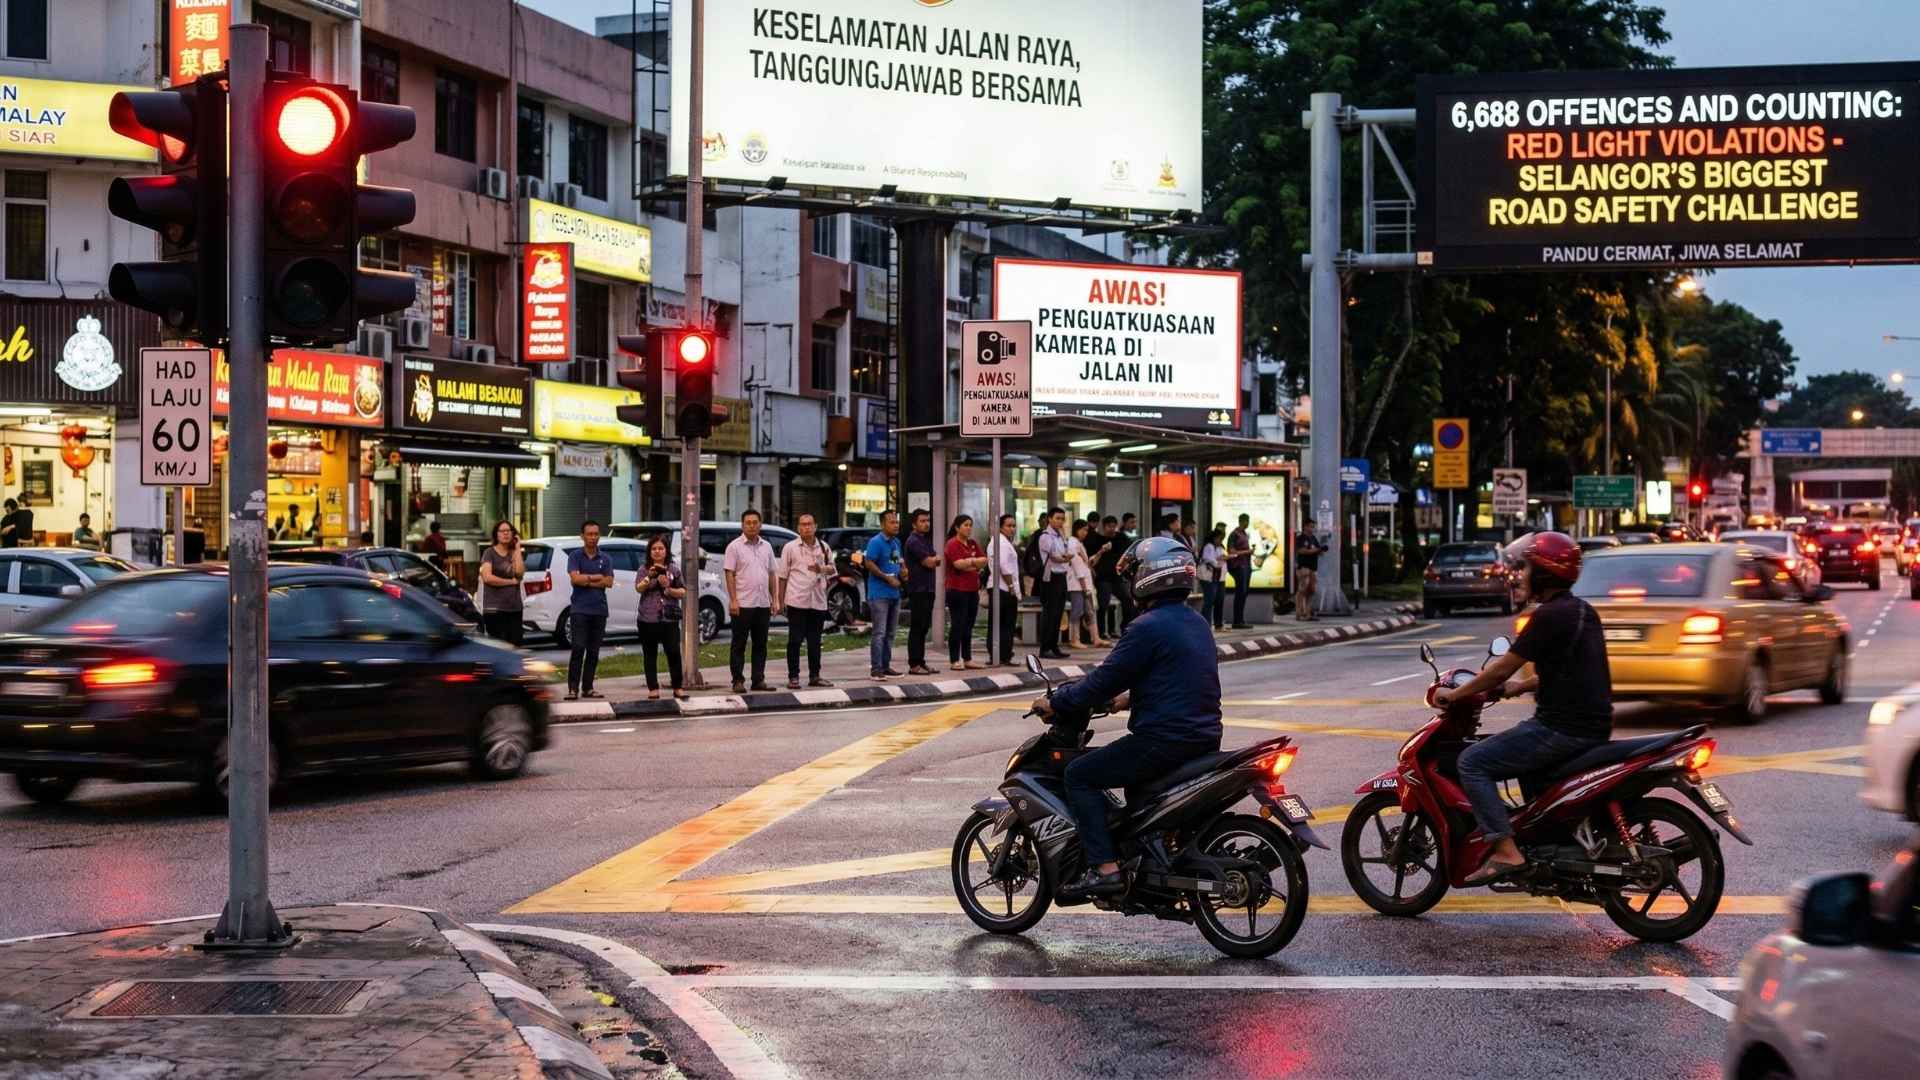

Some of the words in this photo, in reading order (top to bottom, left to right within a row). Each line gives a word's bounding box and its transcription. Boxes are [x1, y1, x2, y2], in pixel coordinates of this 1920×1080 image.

[753, 8, 927, 53] KESELAMATAN
[936, 27, 1009, 61] JALAN
[1018, 36, 1081, 73] RAYA,
[750, 49, 963, 96] TANGGUNGJAWAB
[972, 70, 1082, 108] BERSAMA
[0, 85, 17, 101] N
[1451, 100, 1520, 133] 6,688
[1526, 96, 1674, 127] OFFENCES
[1679, 94, 1739, 122] AND
[1745, 90, 1902, 121] COUNTING:
[9, 130, 56, 145] SIAR
[1507, 132, 1563, 160] RED
[1571, 130, 1652, 158] LIGHT
[1659, 126, 1824, 156] VIOLATIONS
[1518, 161, 1697, 192] SELANGOR’S
[1704, 158, 1829, 189] BIGGEST
[1489, 197, 1567, 225] ROAD
[1574, 194, 1682, 224] SAFETY
[1687, 191, 1858, 221] CHALLENGE
[1542, 246, 1599, 262] PANDU
[1603, 245, 1675, 263] CERMAT,
[1678, 244, 1721, 261] JIWA
[1724, 242, 1804, 260] SELAMAT
[1088, 279, 1167, 306] AWAS!
[1038, 308, 1215, 335] PENGUATKUASAAN
[1035, 334, 1116, 356] KAMERA
[1124, 338, 1142, 356] DI
[156, 361, 196, 379] HAD
[976, 372, 1016, 386] AWAS!
[1079, 361, 1140, 383] JALAN
[1148, 364, 1173, 384] INI
[150, 388, 202, 407] LAJU
[964, 390, 1029, 400] PENGUATKUASAAN
[981, 403, 1013, 413] KAMERA
[972, 415, 980, 426] DI
[983, 415, 1007, 426] JALAN
[1010, 415, 1020, 425] INI
[152, 418, 200, 452] 60
[154, 461, 197, 477] KM/J
